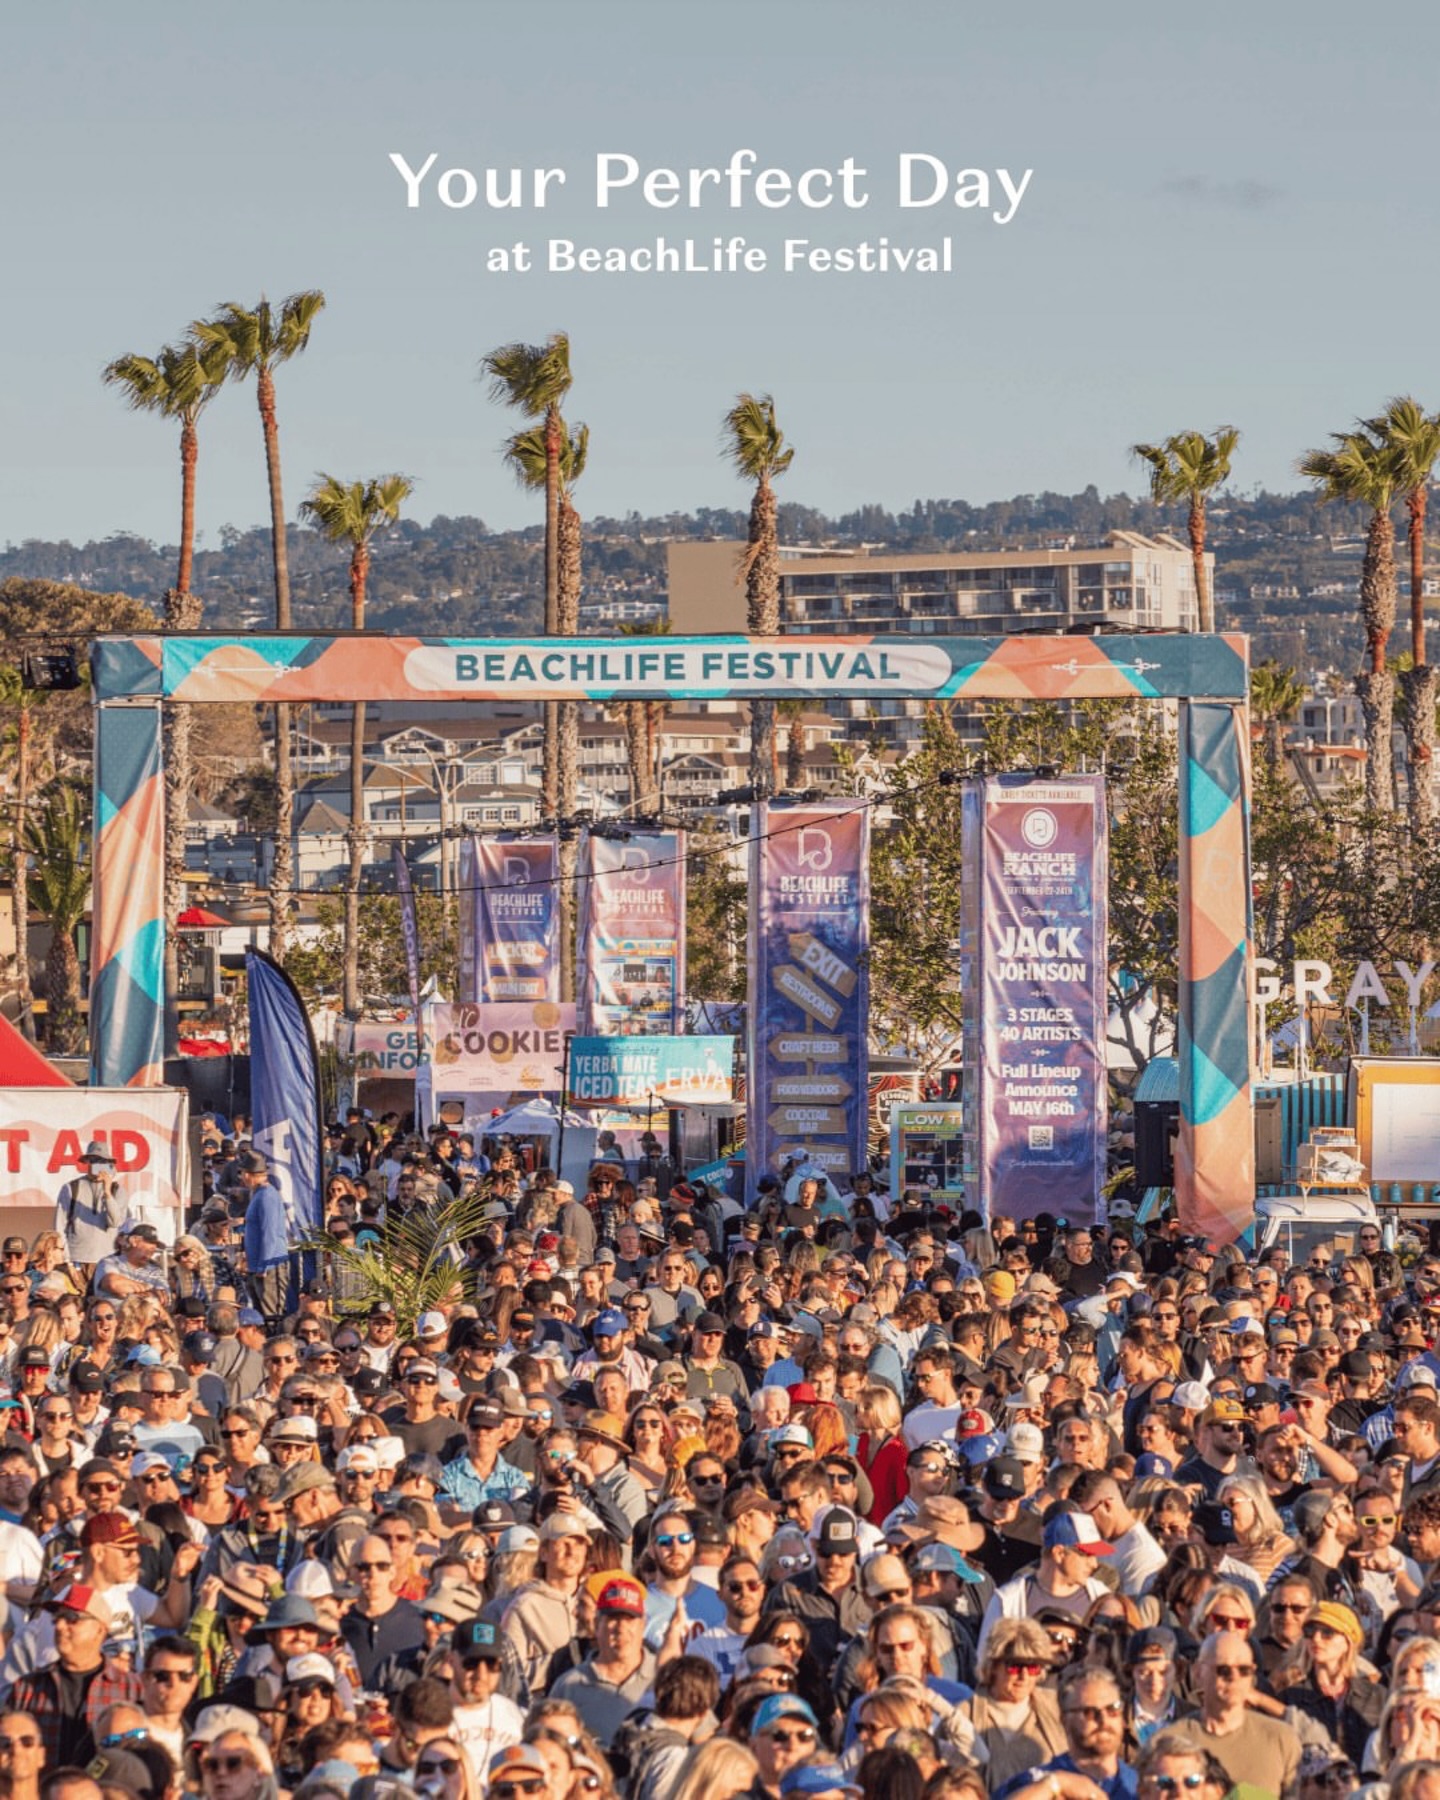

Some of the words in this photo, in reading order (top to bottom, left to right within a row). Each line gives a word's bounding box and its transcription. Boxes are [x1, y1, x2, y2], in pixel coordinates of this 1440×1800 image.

[455, 652, 687, 683] BEACHLIFE
[702, 651, 901, 681] FESTIVAL
[1003, 862, 1076, 876] RANCH
[780, 875, 849, 893] BEACHLIFE
[490, 893, 544, 908] BEACHLIFE
[606, 888, 665, 904] EACHLIFE
[780, 893, 849, 905] FESTIVAL
[998, 926, 1084, 959] JACK
[801, 941, 849, 986] EXIT
[998, 963, 1086, 983] JOHNSON
[1252, 957, 1437, 1006] GRAY
[1007, 1007, 1017, 1023] 3
[1019, 1007, 1074, 1023] STAGES
[1000, 1026, 1020, 1042] 40
[1022, 1025, 1082, 1042] ARTISTS
[575, 1055, 618, 1073] YERBA
[622, 1055, 658, 1073] MATE
[1001, 1064, 1027, 1078] Full
[1032, 1064, 1081, 1081] Lineup
[574, 1075, 614, 1099] ICED
[617, 1074, 658, 1099] TEAS
[1005, 1082, 1078, 1097] Announce
[1009, 1101, 1042, 1115] MAY
[1045, 1101, 1075, 1115] 16th
[903, 1115, 944, 1125] LOW
[0, 1129, 29, 1173] T
[47, 1129, 151, 1174] AD
